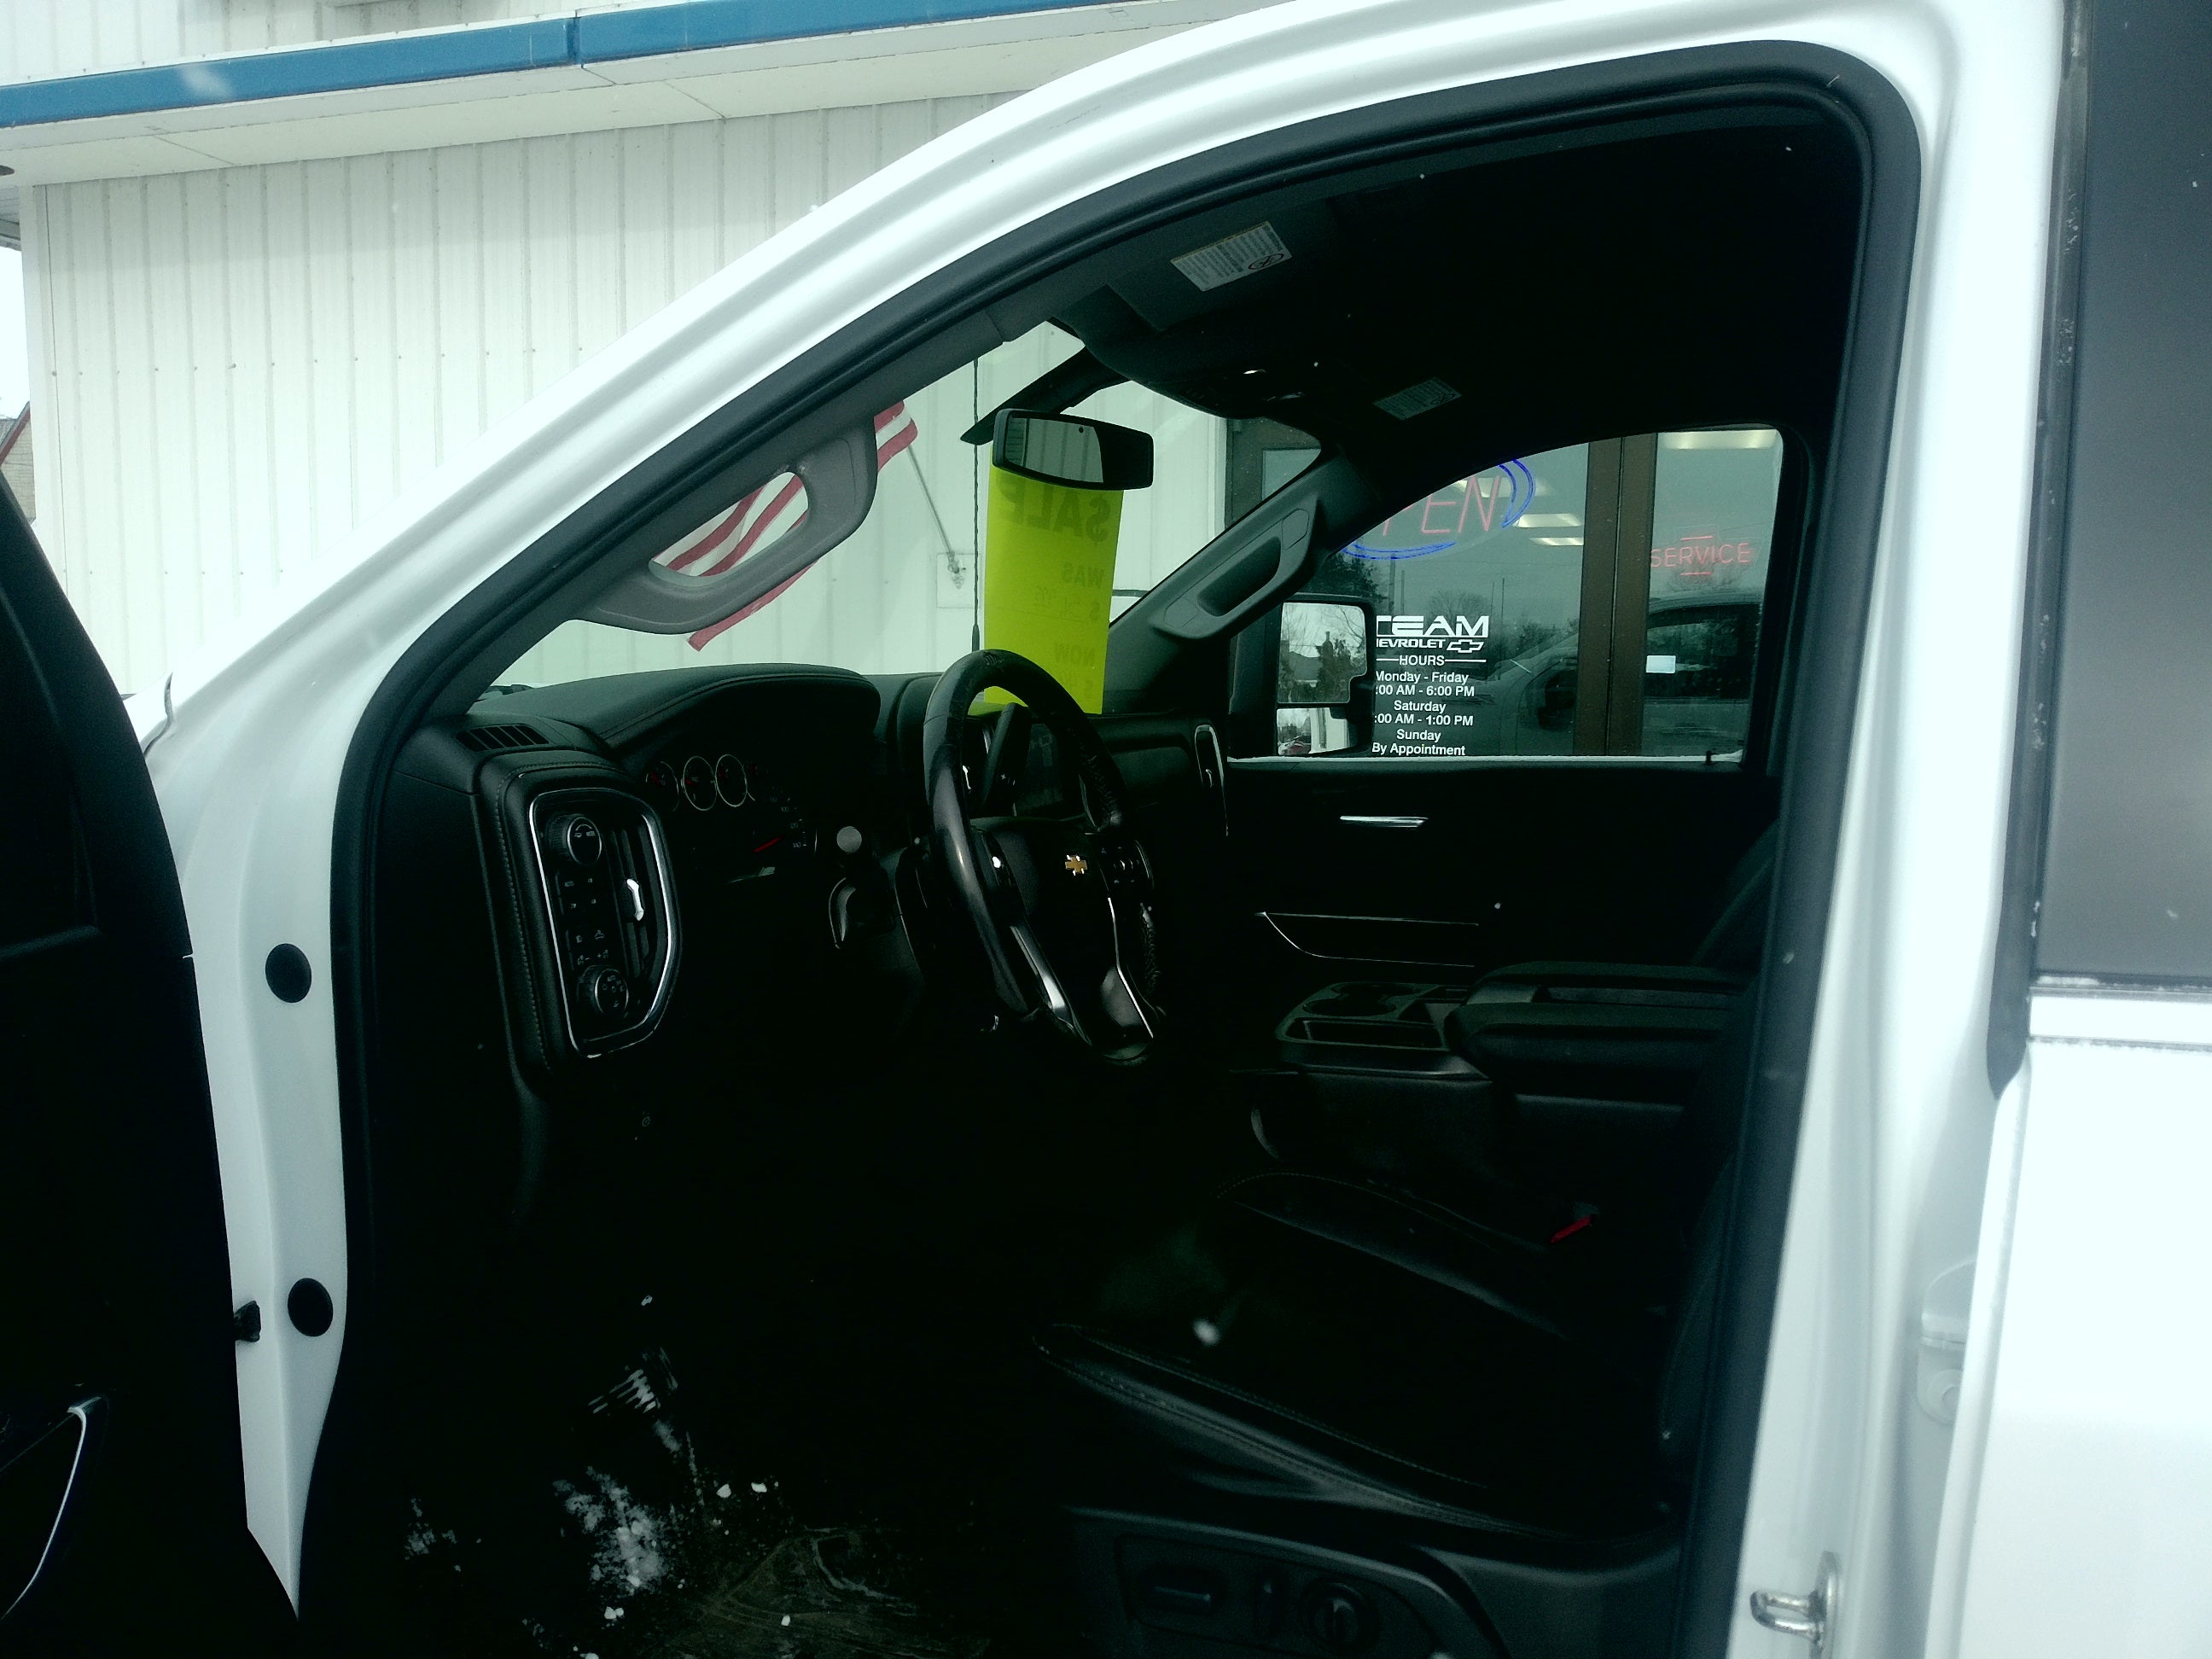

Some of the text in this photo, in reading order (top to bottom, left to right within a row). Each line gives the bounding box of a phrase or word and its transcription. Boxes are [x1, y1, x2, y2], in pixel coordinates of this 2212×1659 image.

[1382, 474, 1501, 537] EN
[1650, 542, 1751, 568] SERVICE
[1376, 638, 1446, 649] EVROLET
[1399, 655, 1445, 666] HOURS
[1376, 671, 1421, 684] Monday
[1431, 672, 1469, 684] Friday
[1375, 684, 1394, 695] :00
[1396, 685, 1415, 696] AM
[1426, 686, 1452, 696] 6:00
[1455, 686, 1475, 696] PM
[1394, 700, 1446, 713] Saturday
[1374, 713, 1392, 724] :00
[1394, 713, 1414, 724] AM
[1425, 715, 1451, 725] 1:00
[1453, 715, 1474, 725] PM
[1396, 729, 1441, 742] Sunday
[1371, 742, 1465, 755] By Appointment
